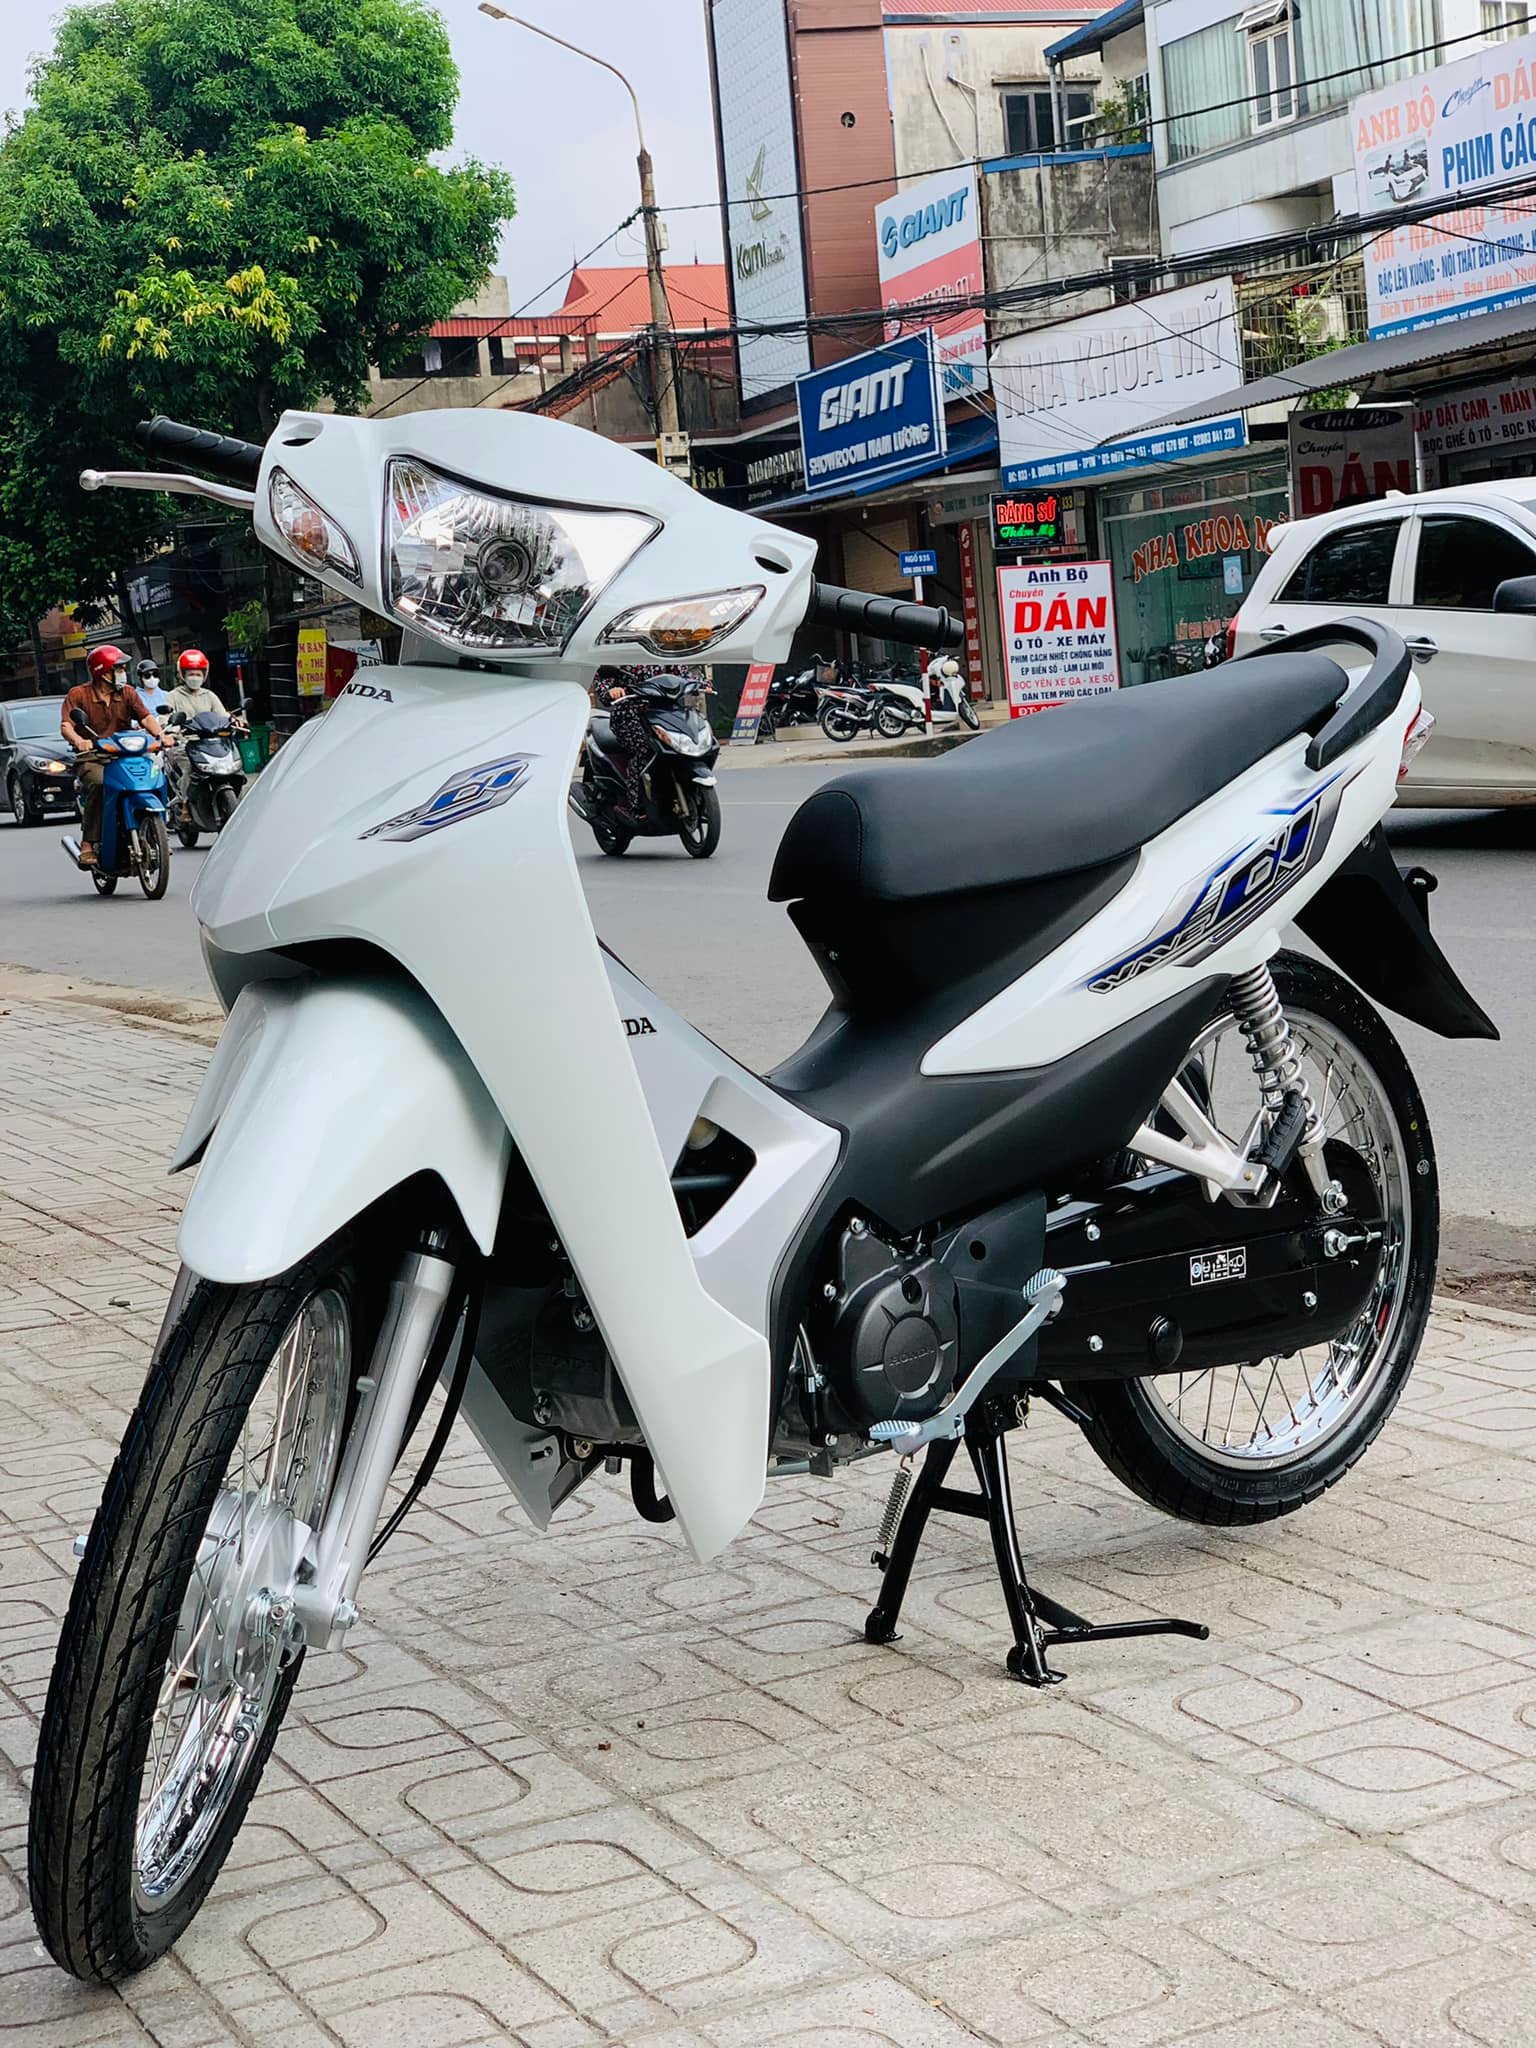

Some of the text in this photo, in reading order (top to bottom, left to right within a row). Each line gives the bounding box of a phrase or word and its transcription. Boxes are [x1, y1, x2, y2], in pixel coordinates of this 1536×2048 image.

[1357, 85, 1435, 152] ANH BỘ
[1442, 133, 1494, 189] PHIM
[900, 187, 968, 248] GIANT
[819, 359, 913, 431] GIANT
[1461, 398, 1490, 422] CAM
[809, 442, 866, 476] SHOWROOM
[868, 434, 892, 458] NAM
[1299, 451, 1411, 514] DÁN
[996, 500, 1035, 525] RĂNG
[1132, 532, 1178, 583] NHA
[1184, 514, 1250, 561] KHOA
[1027, 569, 1060, 583] Anh
[1014, 592, 1107, 634] DÁN
[1010, 655, 1028, 663] PHIM
[1056, 636, 1073, 647] XE
[1077, 633, 1106, 645] MÁY
[1041, 690, 1057, 700] TEM
[1054, 678, 1066, 686] XE
[1069, 677, 1081, 685] GA
[1089, 674, 1100, 683] XE
